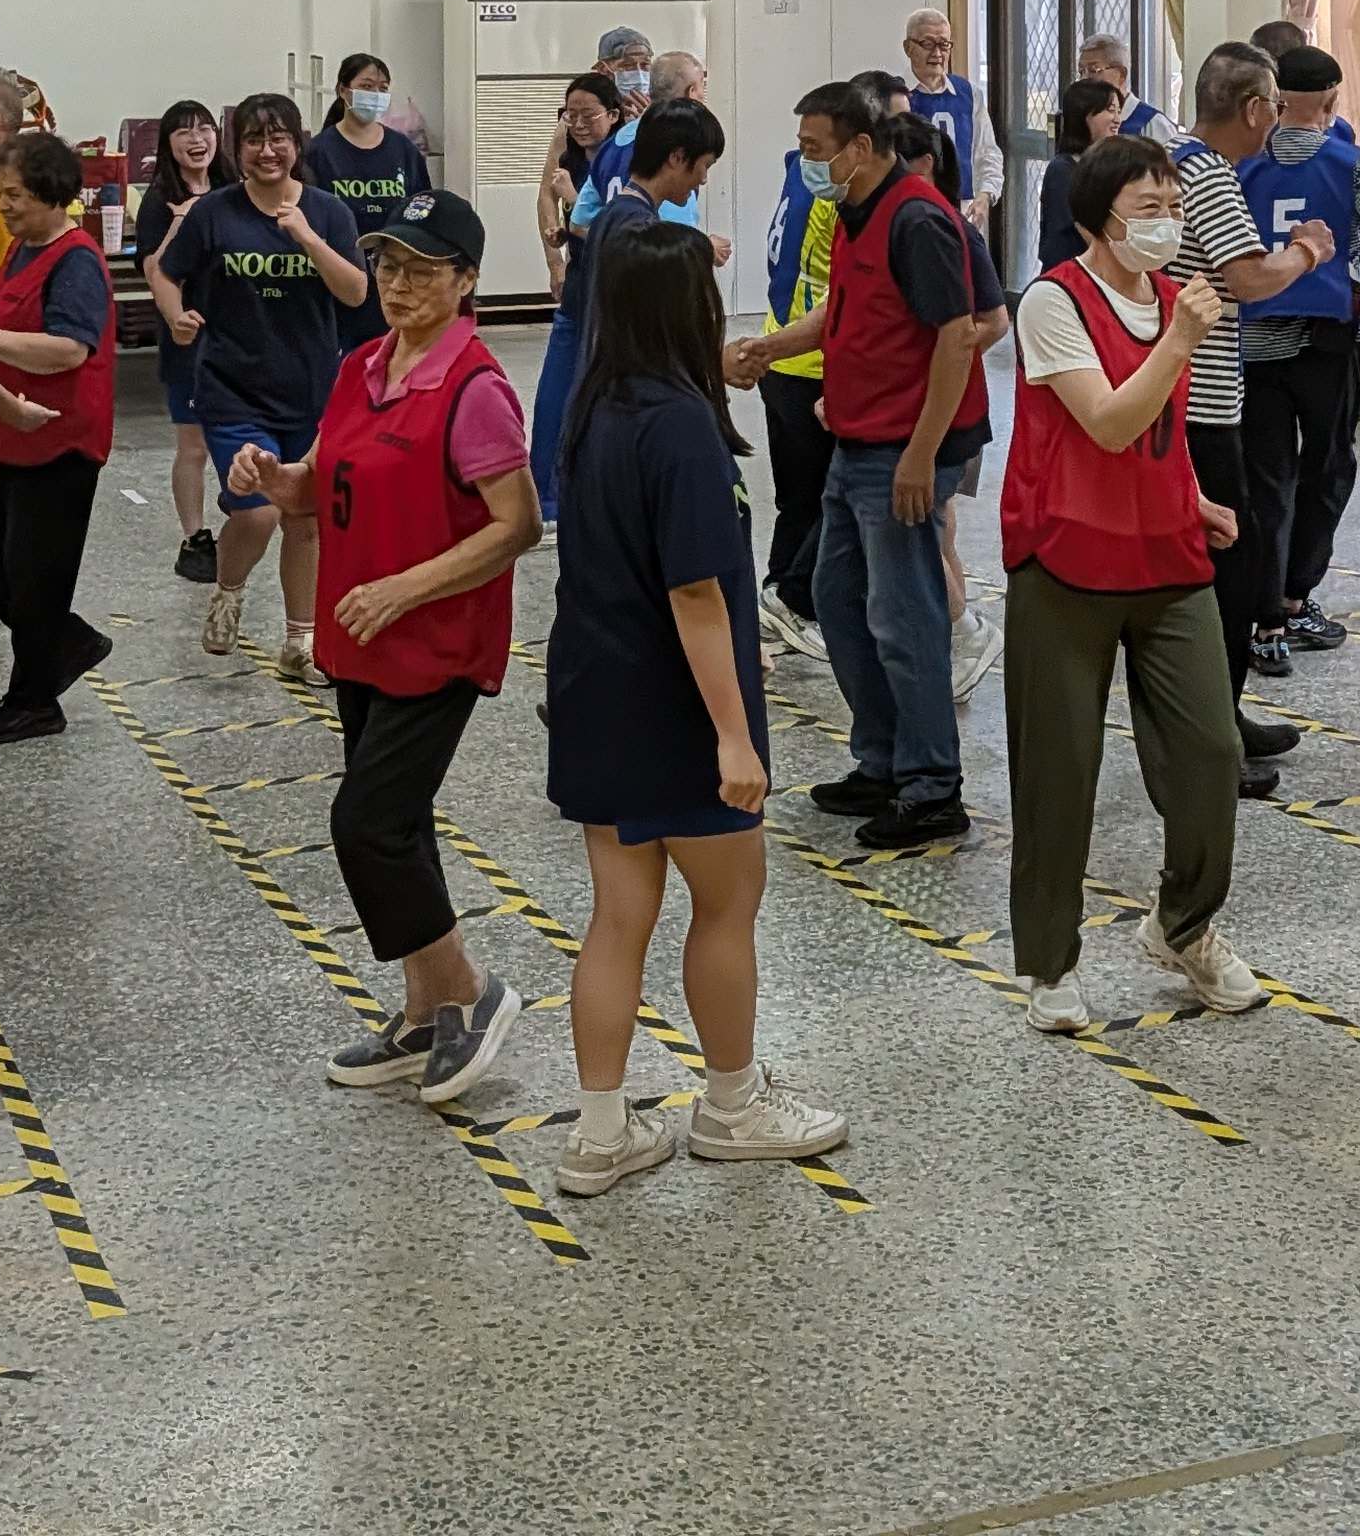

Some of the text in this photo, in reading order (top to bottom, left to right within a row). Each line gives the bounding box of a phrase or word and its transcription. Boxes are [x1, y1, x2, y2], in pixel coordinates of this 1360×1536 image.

[481, 5, 516, 14] TECO
[332, 179, 406, 198] NOCRS
[332, 459, 353, 531] 5
